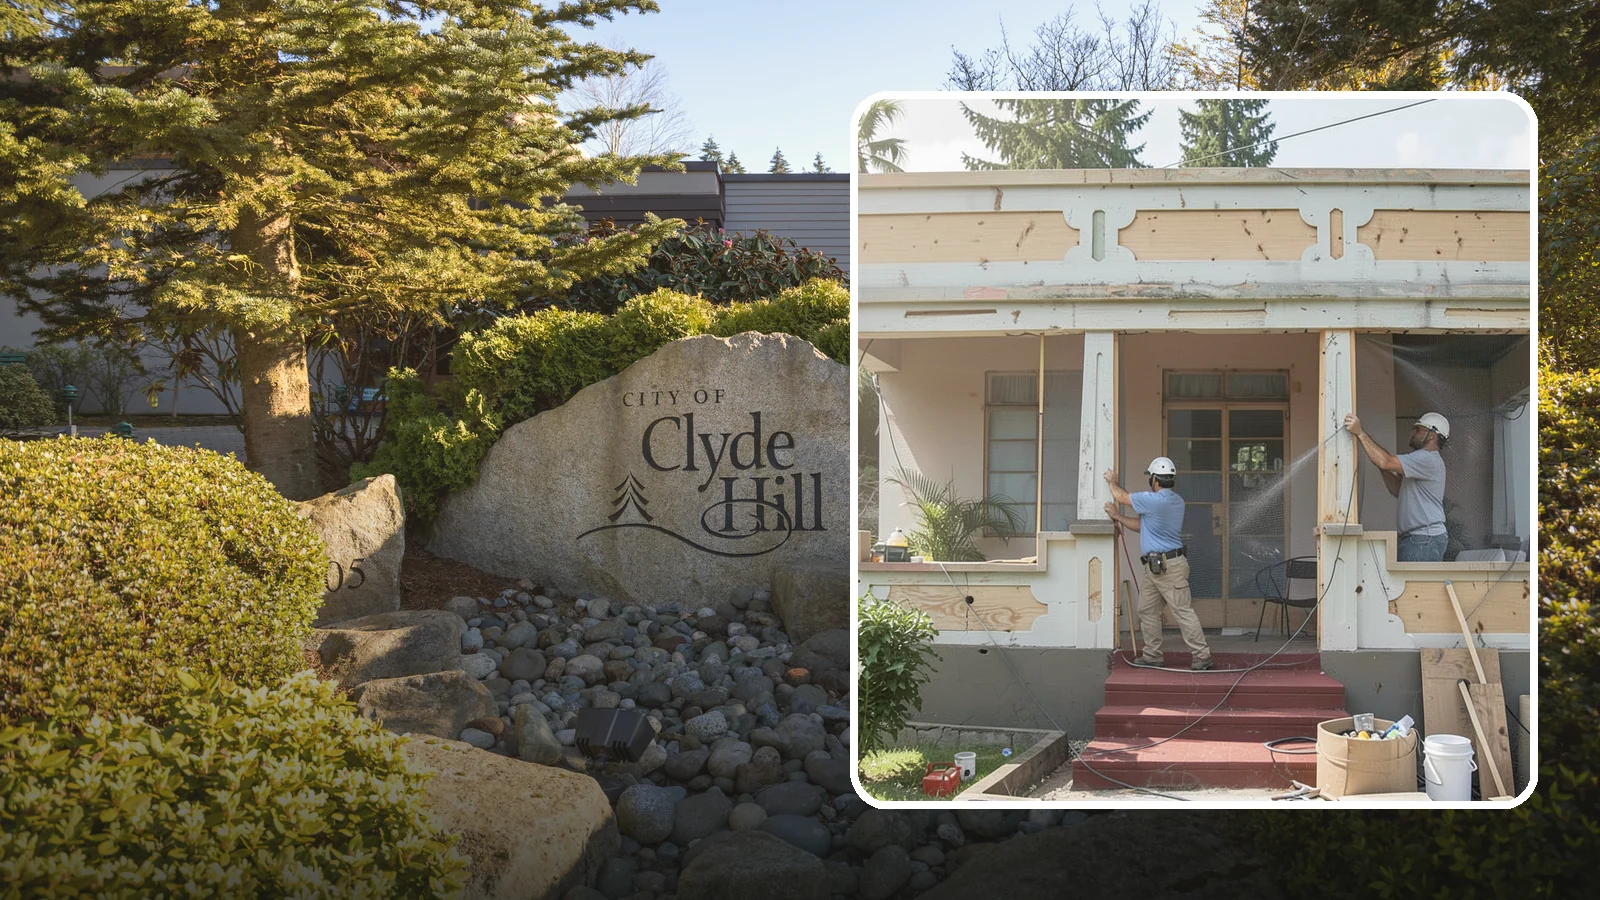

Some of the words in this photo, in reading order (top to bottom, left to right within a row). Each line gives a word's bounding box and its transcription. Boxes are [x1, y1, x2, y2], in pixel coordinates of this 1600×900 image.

[623, 389, 680, 407] CITY
[694, 389, 725, 404] OF
[642, 411, 794, 492] Clyde
[718, 472, 827, 532] Hill
